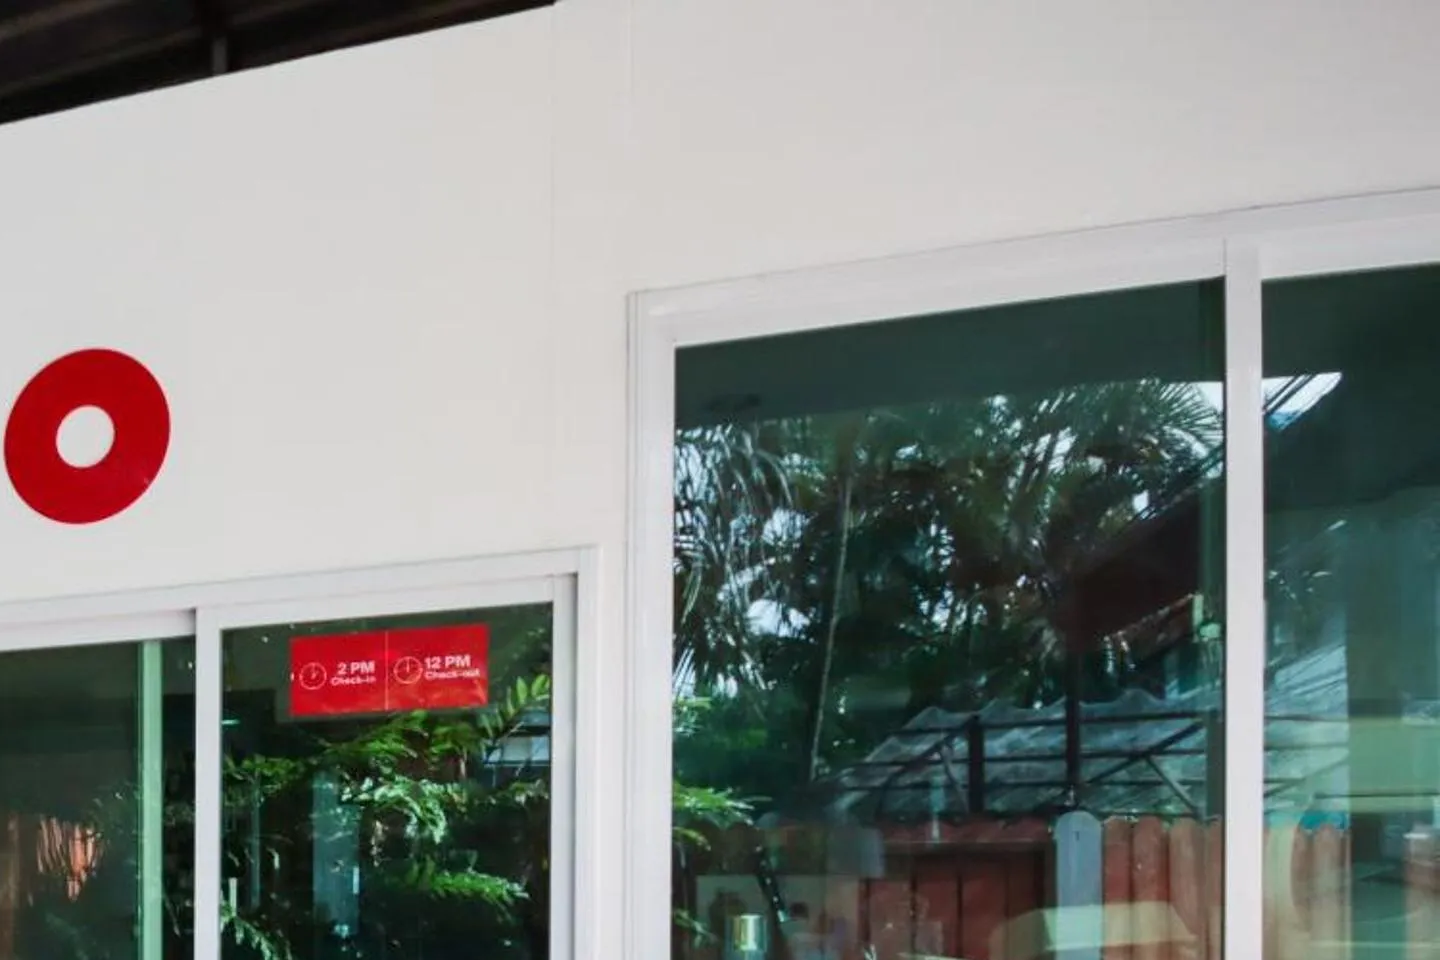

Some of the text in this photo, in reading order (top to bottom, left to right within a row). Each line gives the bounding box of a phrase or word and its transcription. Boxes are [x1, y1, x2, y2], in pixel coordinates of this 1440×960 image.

[338, 661, 375, 675] 2 PM
[424, 654, 471, 669] 12 PM
